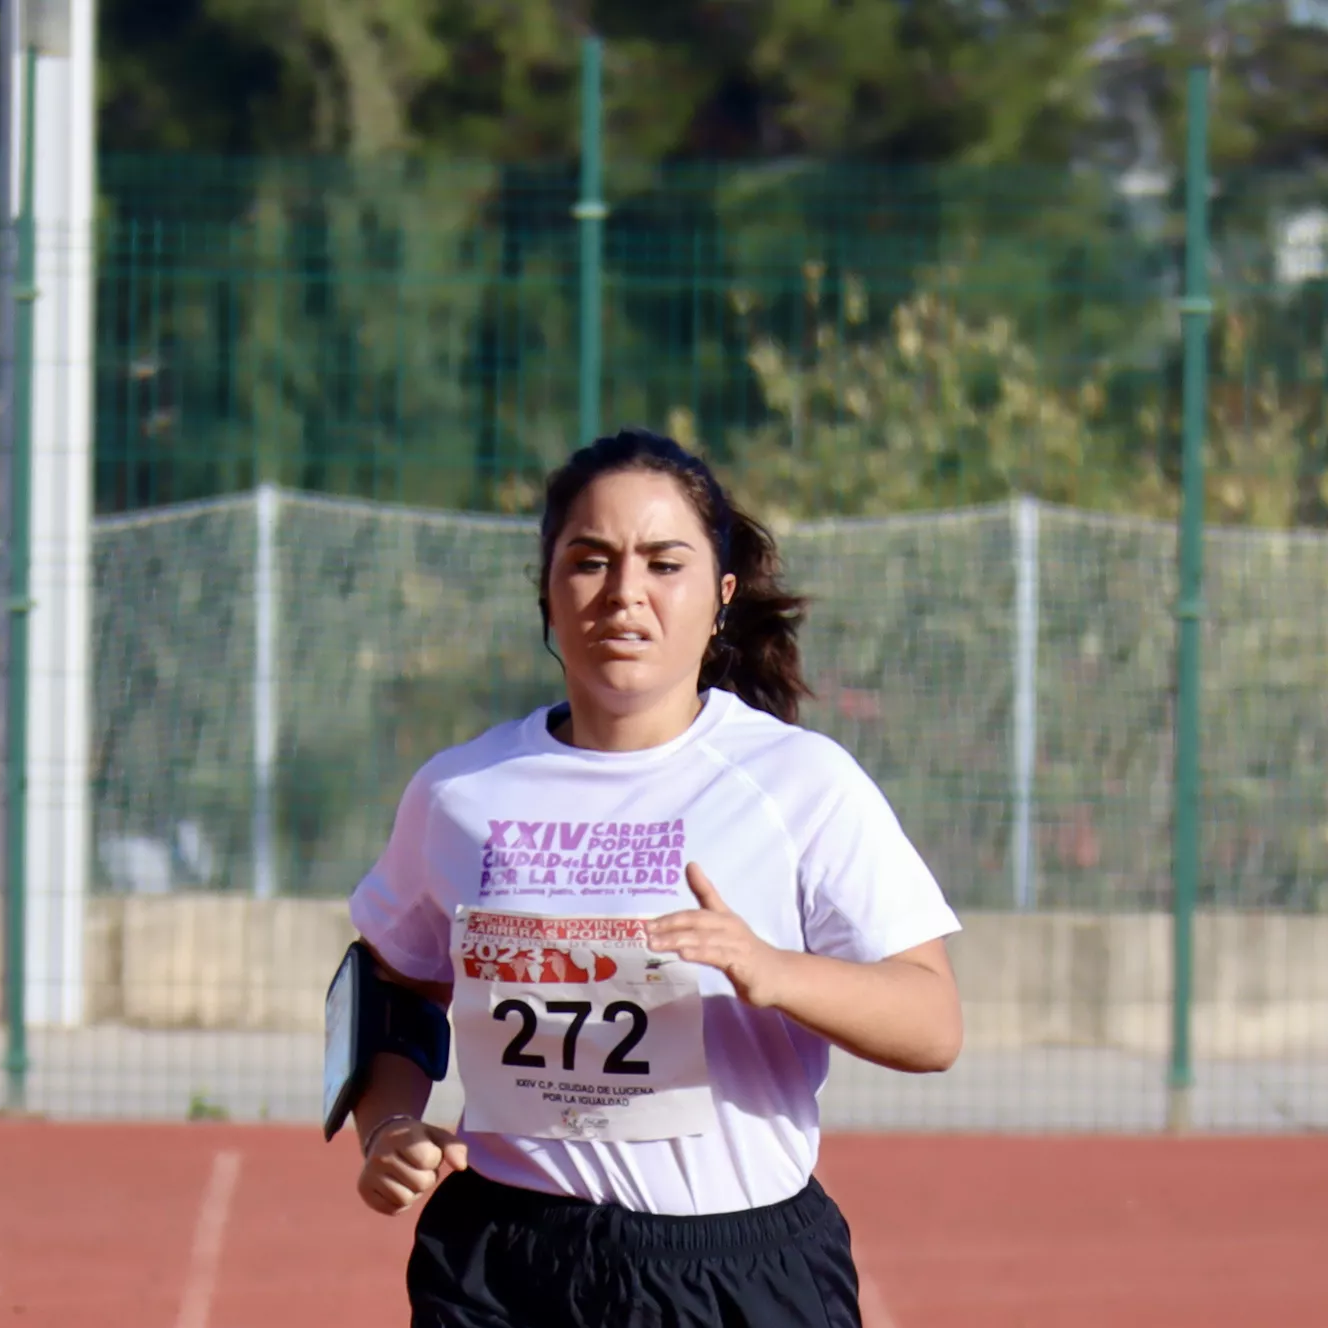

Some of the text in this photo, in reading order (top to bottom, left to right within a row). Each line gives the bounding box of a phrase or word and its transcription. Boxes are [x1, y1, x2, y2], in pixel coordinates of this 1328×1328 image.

[484, 818, 684, 851] XXIV CARRERA
[587, 834, 685, 851] POPULAR
[482, 850, 561, 869] CIUDAD
[581, 850, 682, 869] LUCENA
[481, 868, 680, 888] POR LA IGUALDAD
[542, 919, 645, 930] PROVINCIA
[461, 939, 546, 964] 2023
[492, 998, 650, 1075] 272
[516, 1078, 536, 1089] XXIV
[559, 1082, 595, 1094] CIUDAD
[597, 1085, 610, 1095] DE
[612, 1086, 655, 1096] LUCENA
[542, 1092, 630, 1107] POR LA IGUALDAD
